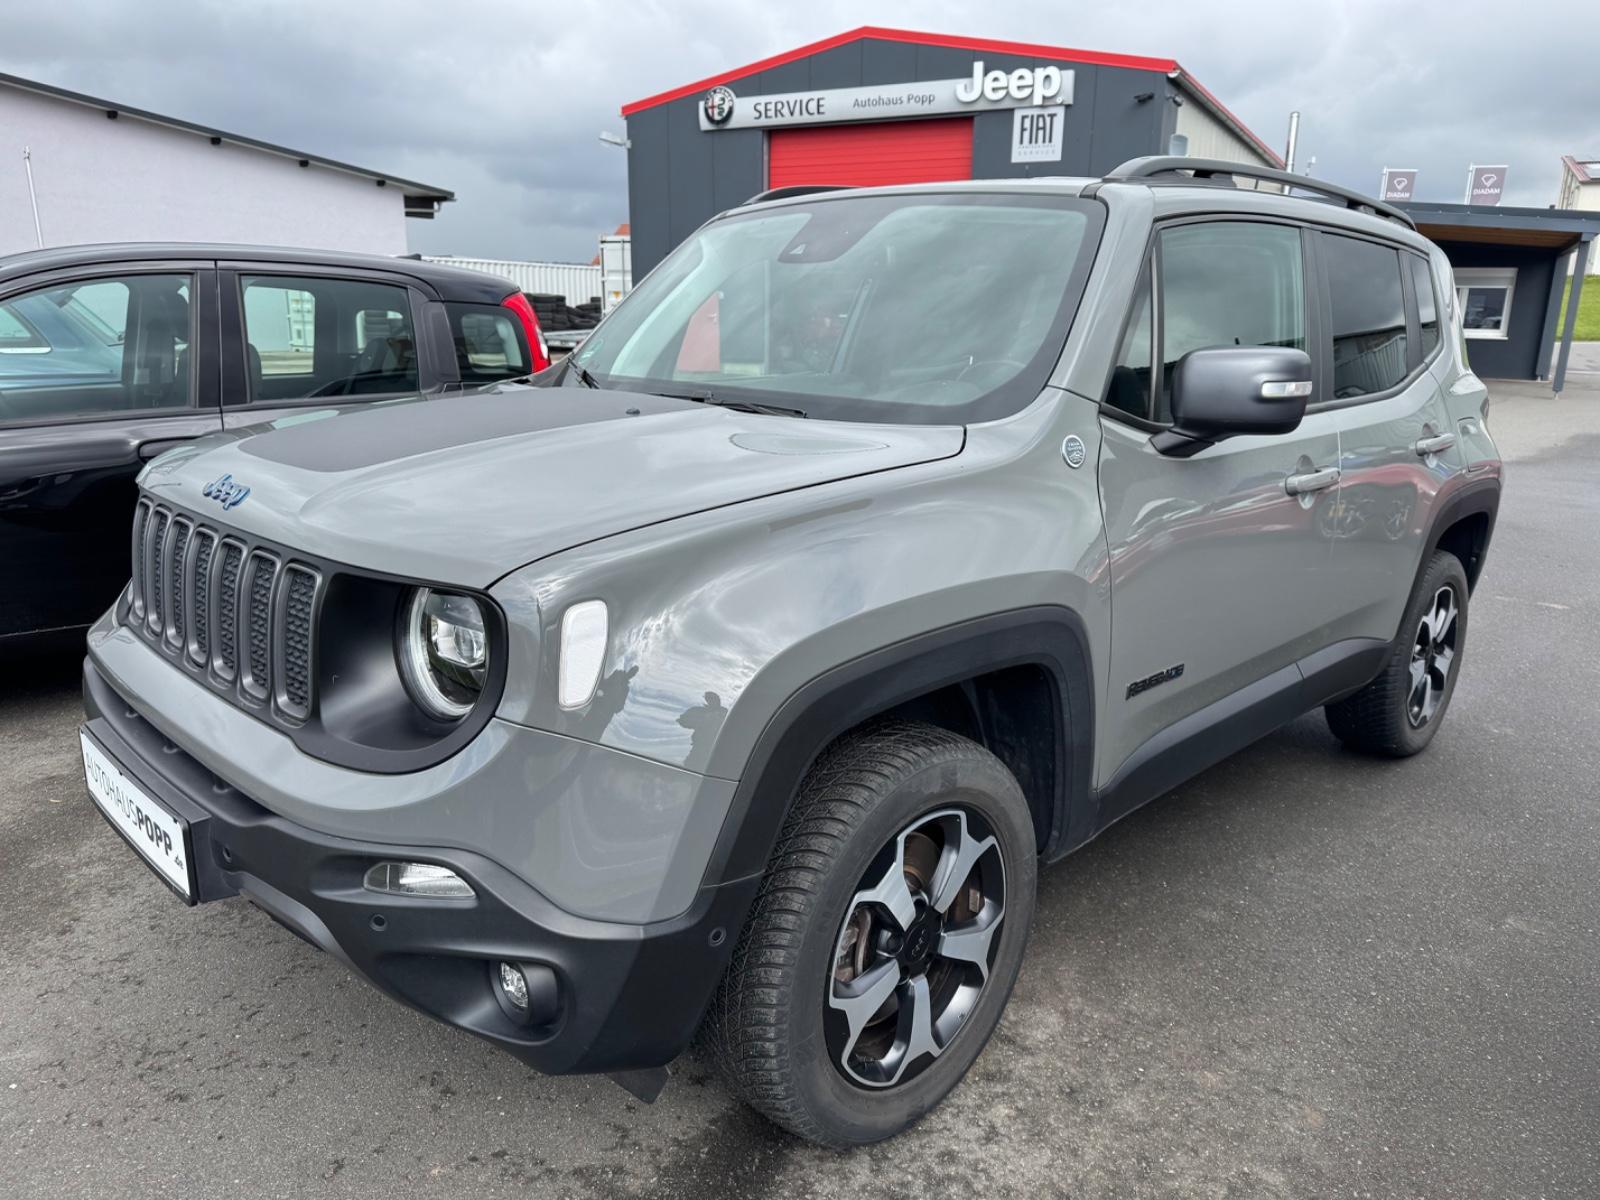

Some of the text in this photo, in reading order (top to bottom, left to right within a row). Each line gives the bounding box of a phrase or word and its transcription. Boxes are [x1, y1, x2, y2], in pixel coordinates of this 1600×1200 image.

[956, 61, 1061, 105] Jeep
[753, 97, 826, 120] SERVICE
[853, 93, 936, 108] Autohaus Popp
[1019, 112, 1058, 145] FIAT
[203, 474, 251, 511] Jeep
